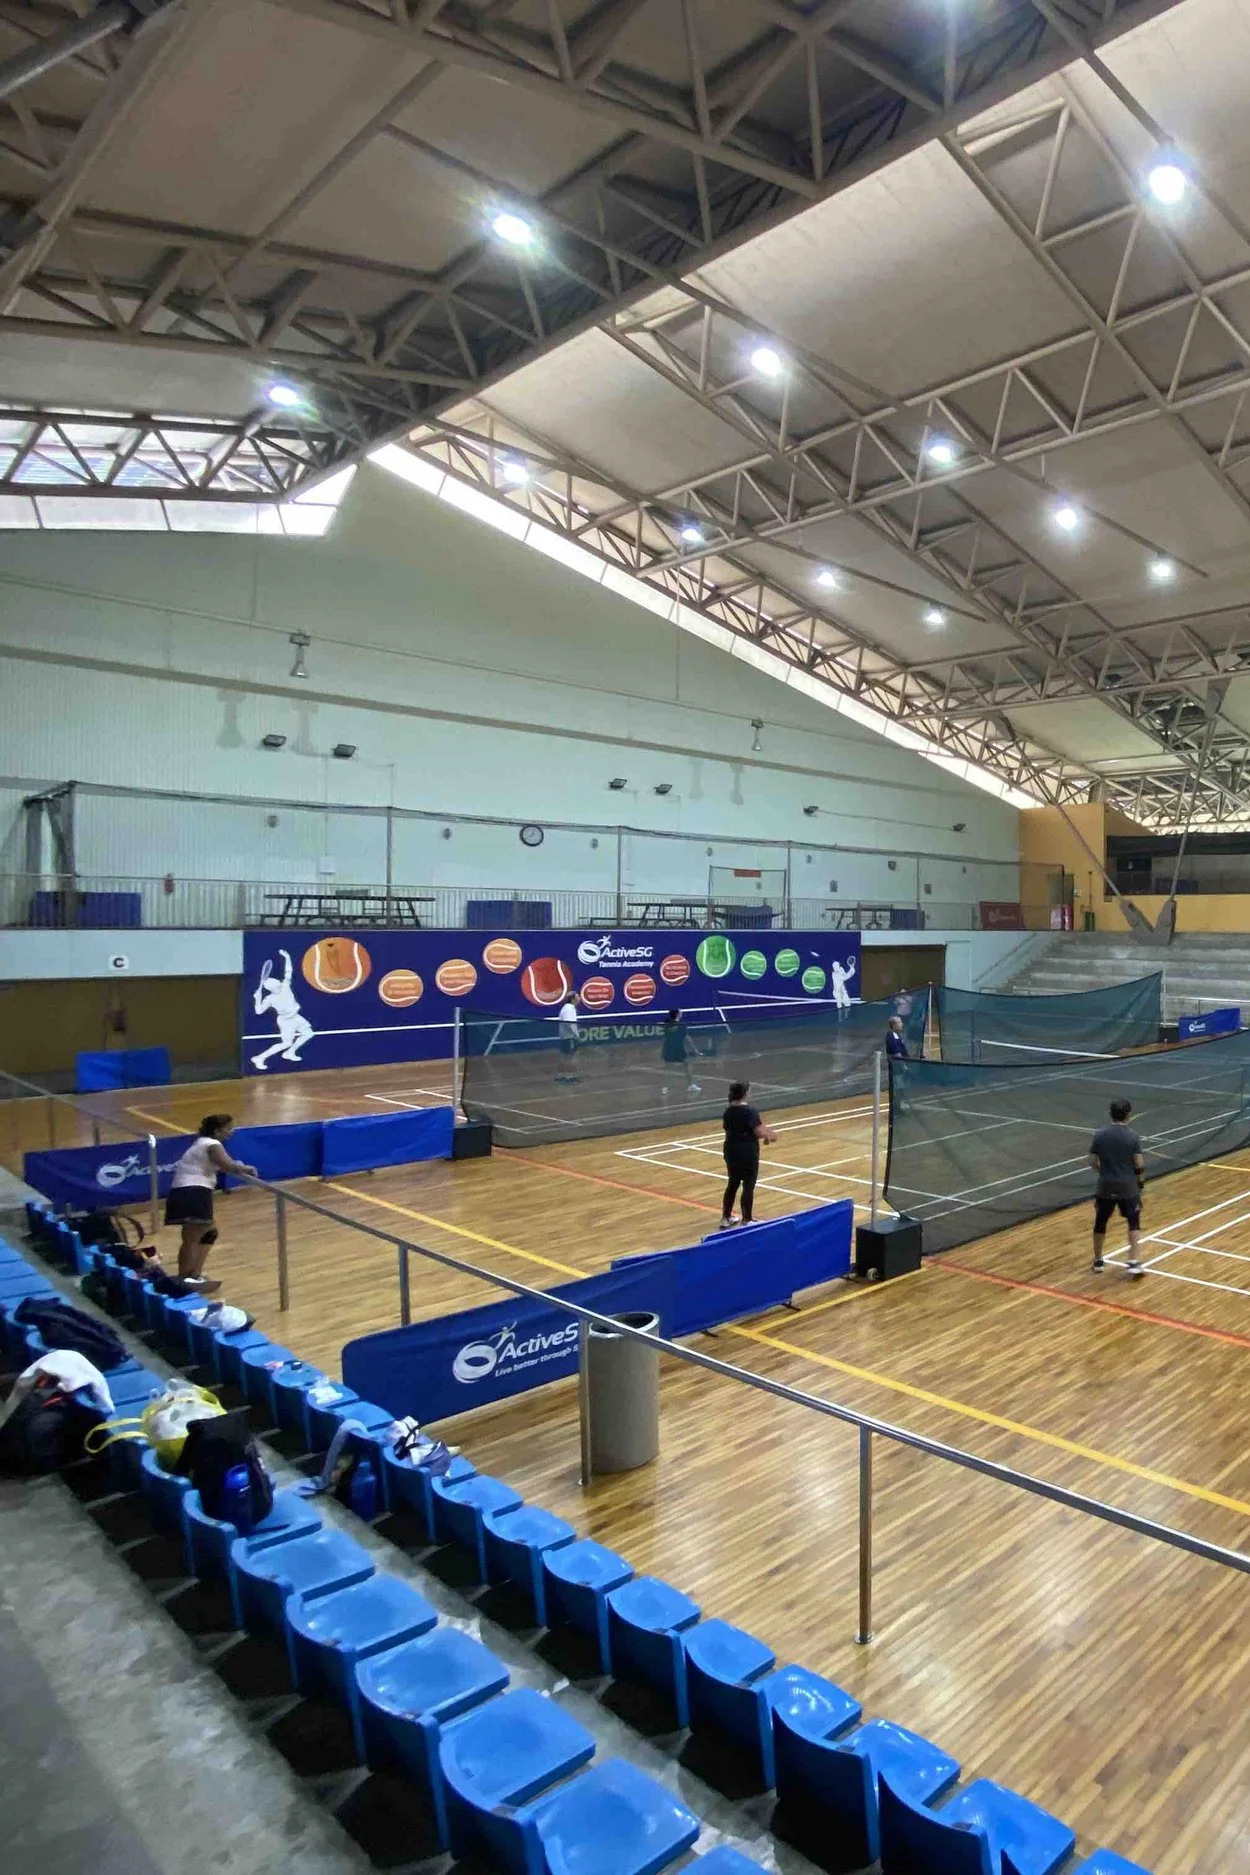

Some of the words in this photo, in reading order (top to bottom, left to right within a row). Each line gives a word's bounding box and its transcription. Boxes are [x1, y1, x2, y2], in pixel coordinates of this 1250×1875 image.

[600, 946, 653, 958] ActiveSG
[113, 957, 124, 968] C
[578, 1026, 610, 1041] ORE
[612, 1025, 666, 1039] VALUE
[498, 1322, 579, 1363] ActiveS
[495, 1366, 512, 1377] Live
[513, 1358, 539, 1371] better
[540, 1347, 572, 1362] through
